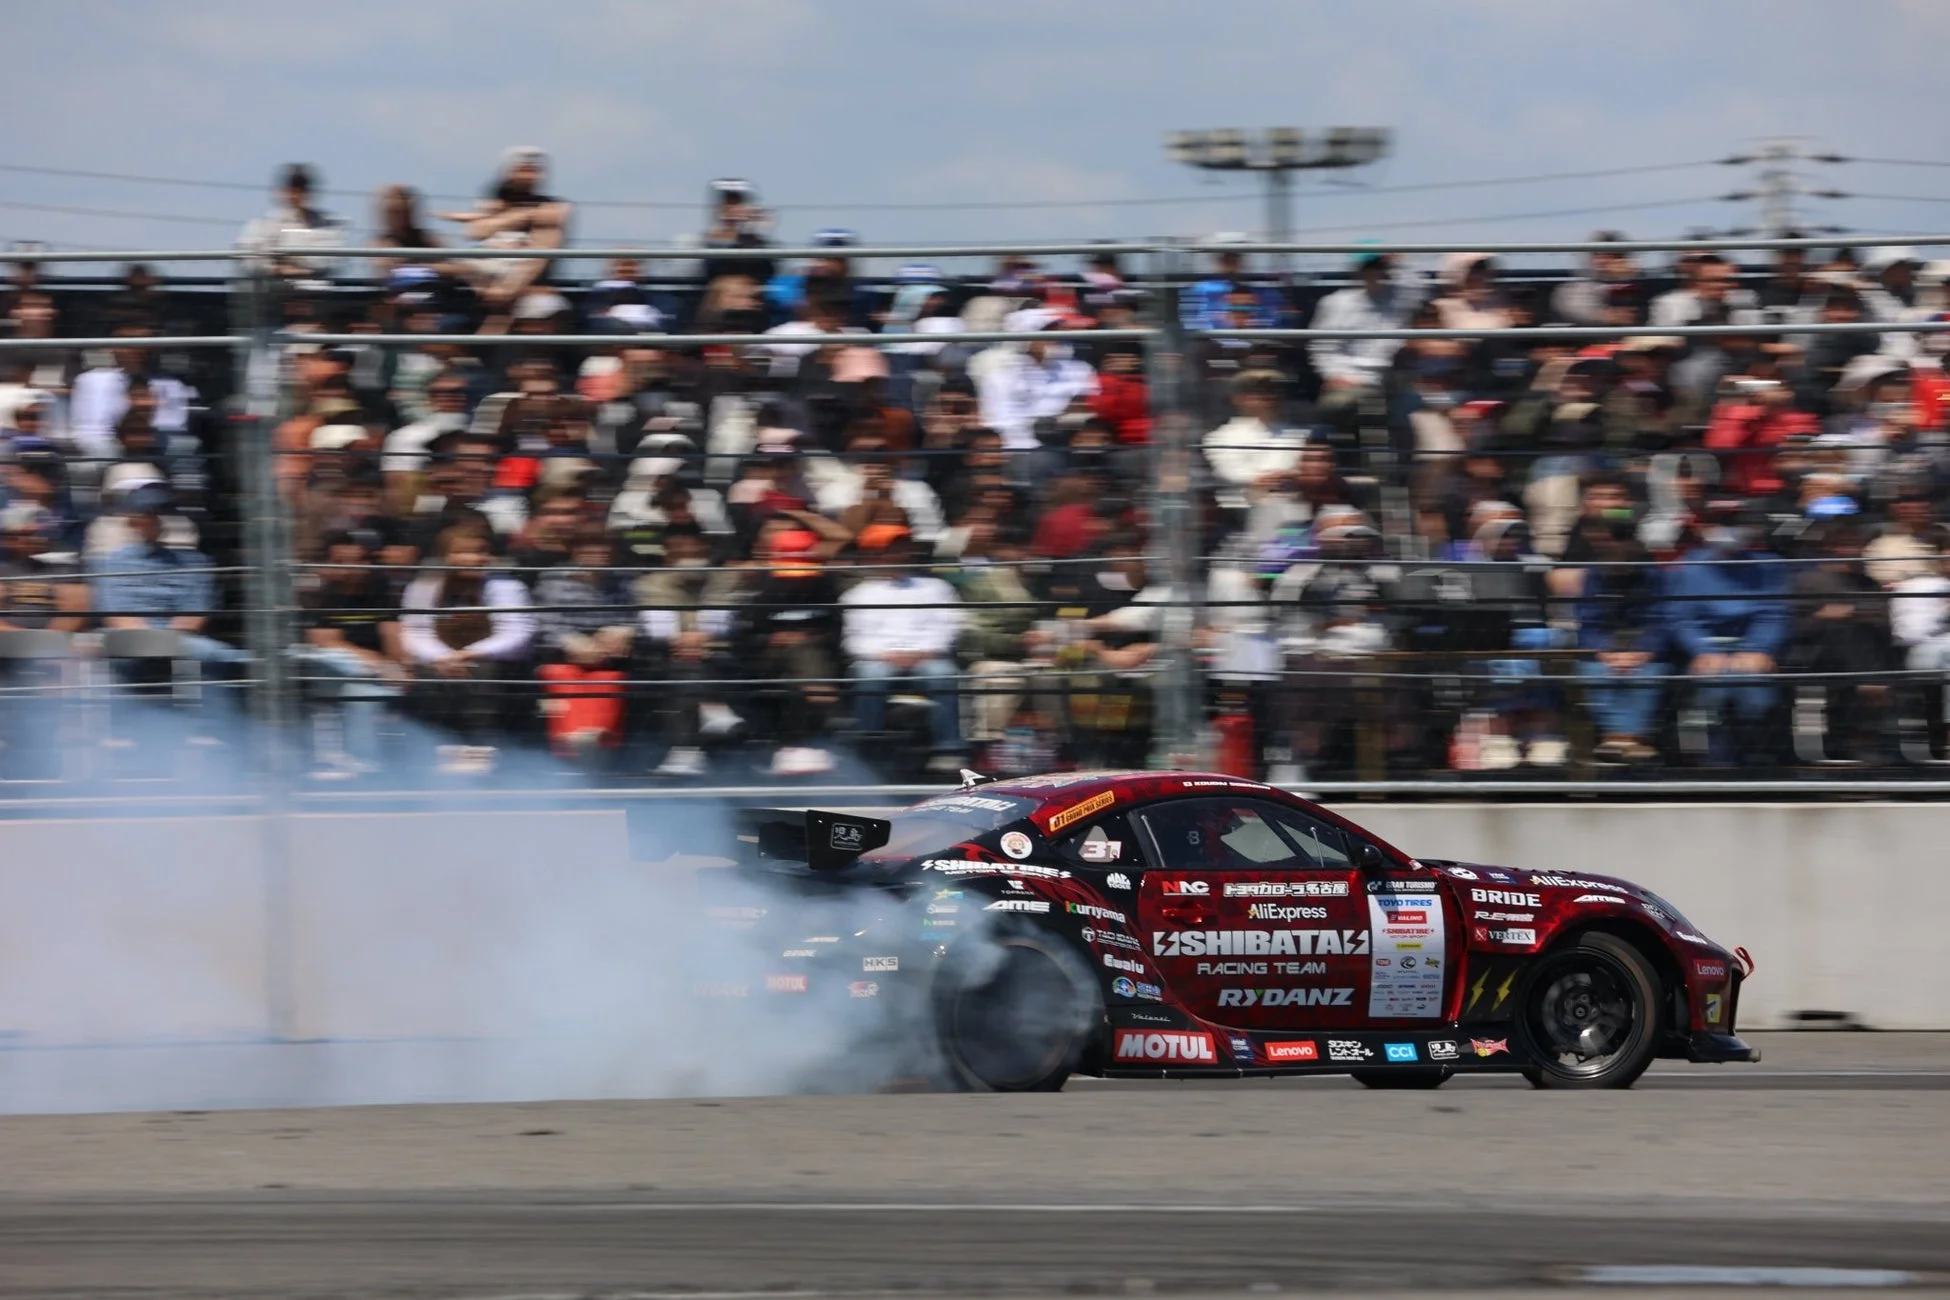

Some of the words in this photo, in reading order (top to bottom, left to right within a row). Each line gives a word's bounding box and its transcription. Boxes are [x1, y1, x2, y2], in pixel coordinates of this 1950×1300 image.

[1054, 814, 1065, 828] D1
[1066, 808, 1083, 822] GRAND
[1083, 803, 1095, 814] PRIX
[1095, 796, 1113, 808] SERIES
[1082, 841, 1121, 859] 31
[1386, 881, 1404, 889] GRAN
[1405, 881, 1435, 889] TURISMO
[1529, 875, 1629, 894] AliExpress
[1378, 899, 1403, 907] TOYO
[1405, 899, 1432, 907] TIRES
[1471, 889, 1542, 907] BRIDE
[982, 900, 1050, 912] AME
[1065, 901, 1126, 923] Kuriyama
[1247, 904, 1327, 922] AliExpress
[1180, 930, 1344, 955] SHIBATA
[1488, 930, 1532, 941] VERTEX
[864, 957, 897, 967] HKS
[1197, 962, 1268, 975] RACING
[1273, 962, 1326, 975] TEAM
[1697, 964, 1724, 976] Lenovo
[766, 976, 804, 990] MOTUL
[1217, 987, 1355, 1006] RYDANZ
[1118, 1034, 1213, 1059] MOTUL
[1270, 1045, 1313, 1058] Lenovo
[1388, 1047, 1413, 1058] CCI
